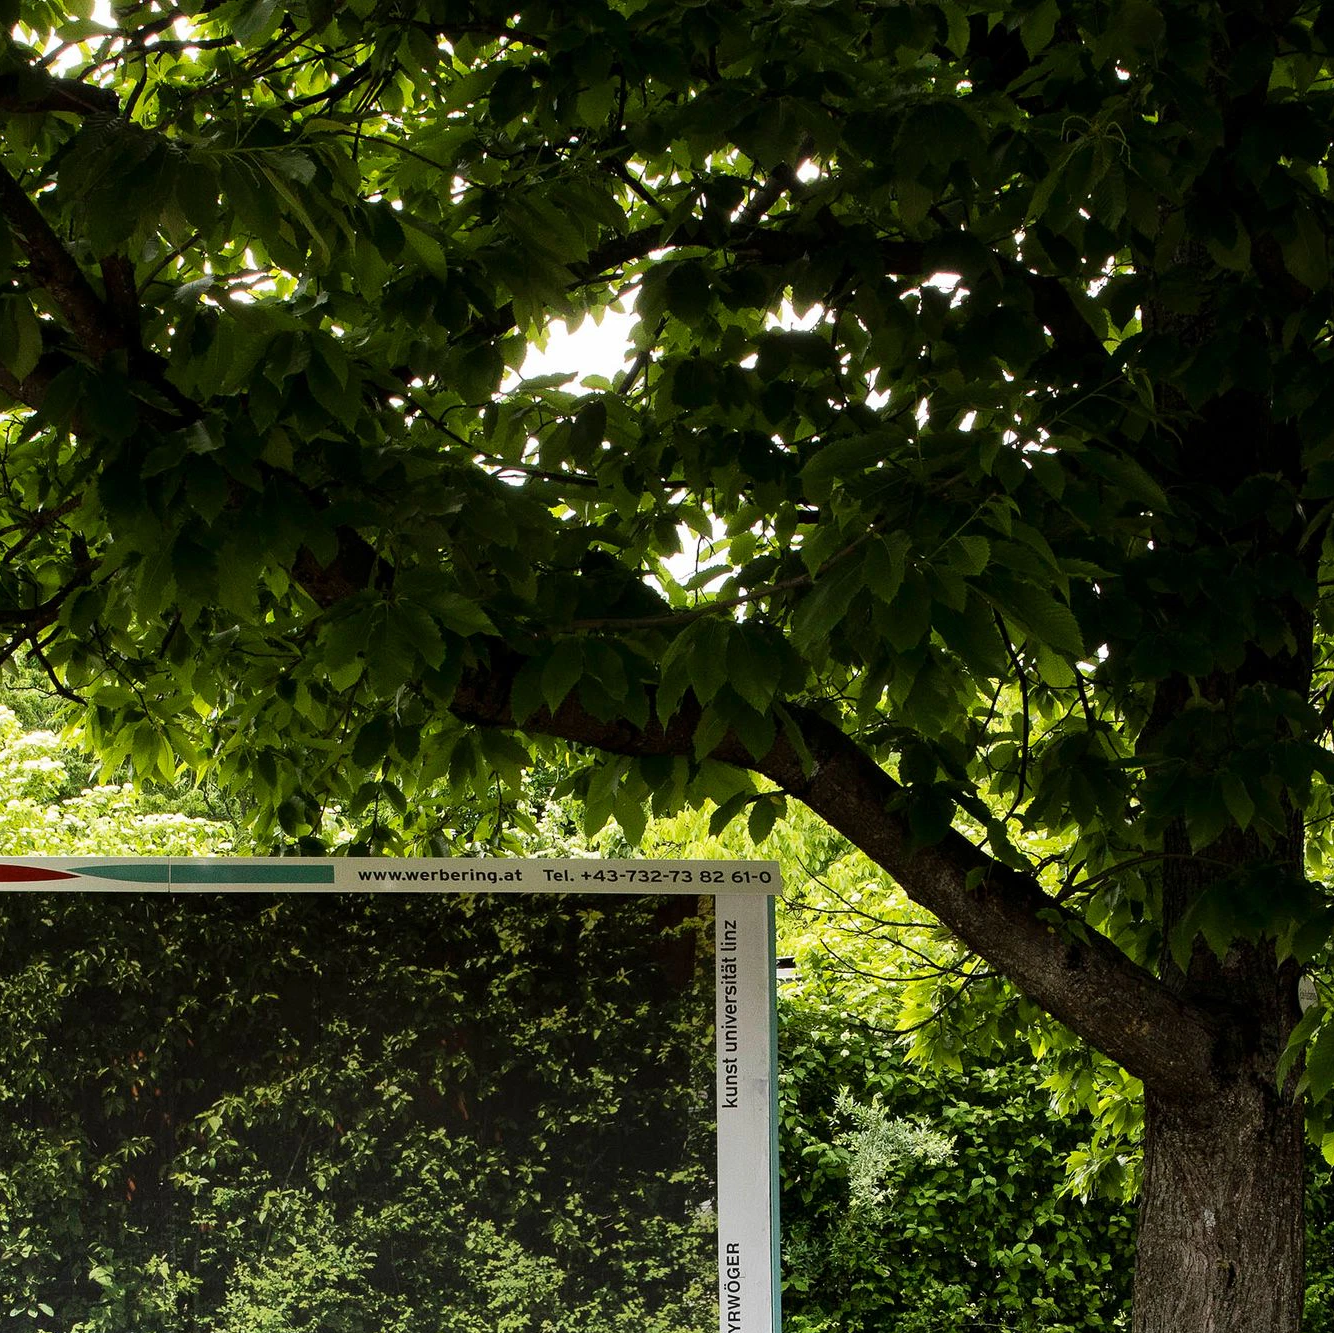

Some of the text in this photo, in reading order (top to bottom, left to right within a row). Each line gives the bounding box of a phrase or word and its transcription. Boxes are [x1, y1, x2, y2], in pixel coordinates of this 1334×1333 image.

[358, 868, 773, 884] www.werbering.at Tel. +43-732-73 82 61-0
[720, 920, 738, 1109] kunst universität linz
